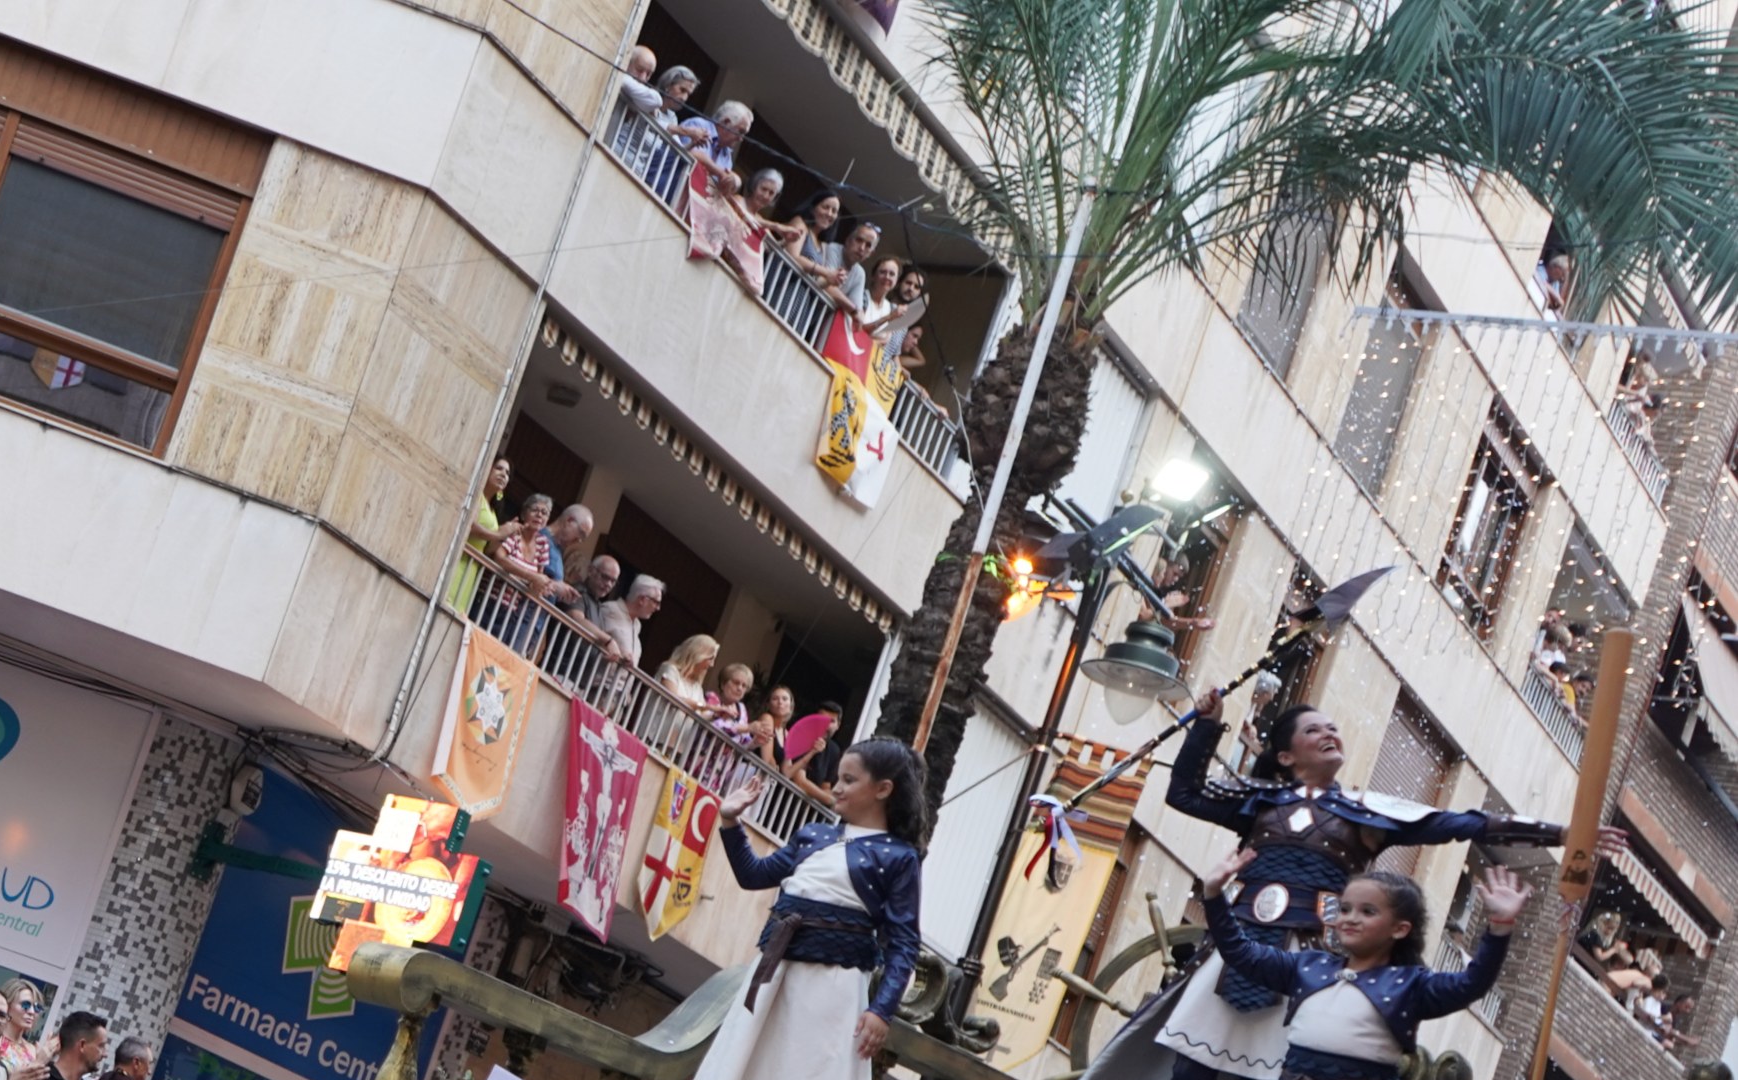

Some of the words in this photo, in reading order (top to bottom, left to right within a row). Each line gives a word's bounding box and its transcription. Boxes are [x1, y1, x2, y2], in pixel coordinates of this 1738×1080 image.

[351, 863, 419, 890] DESCUENTO
[419, 879, 459, 900] DESDE
[186, 973, 313, 1056] Farmacia
